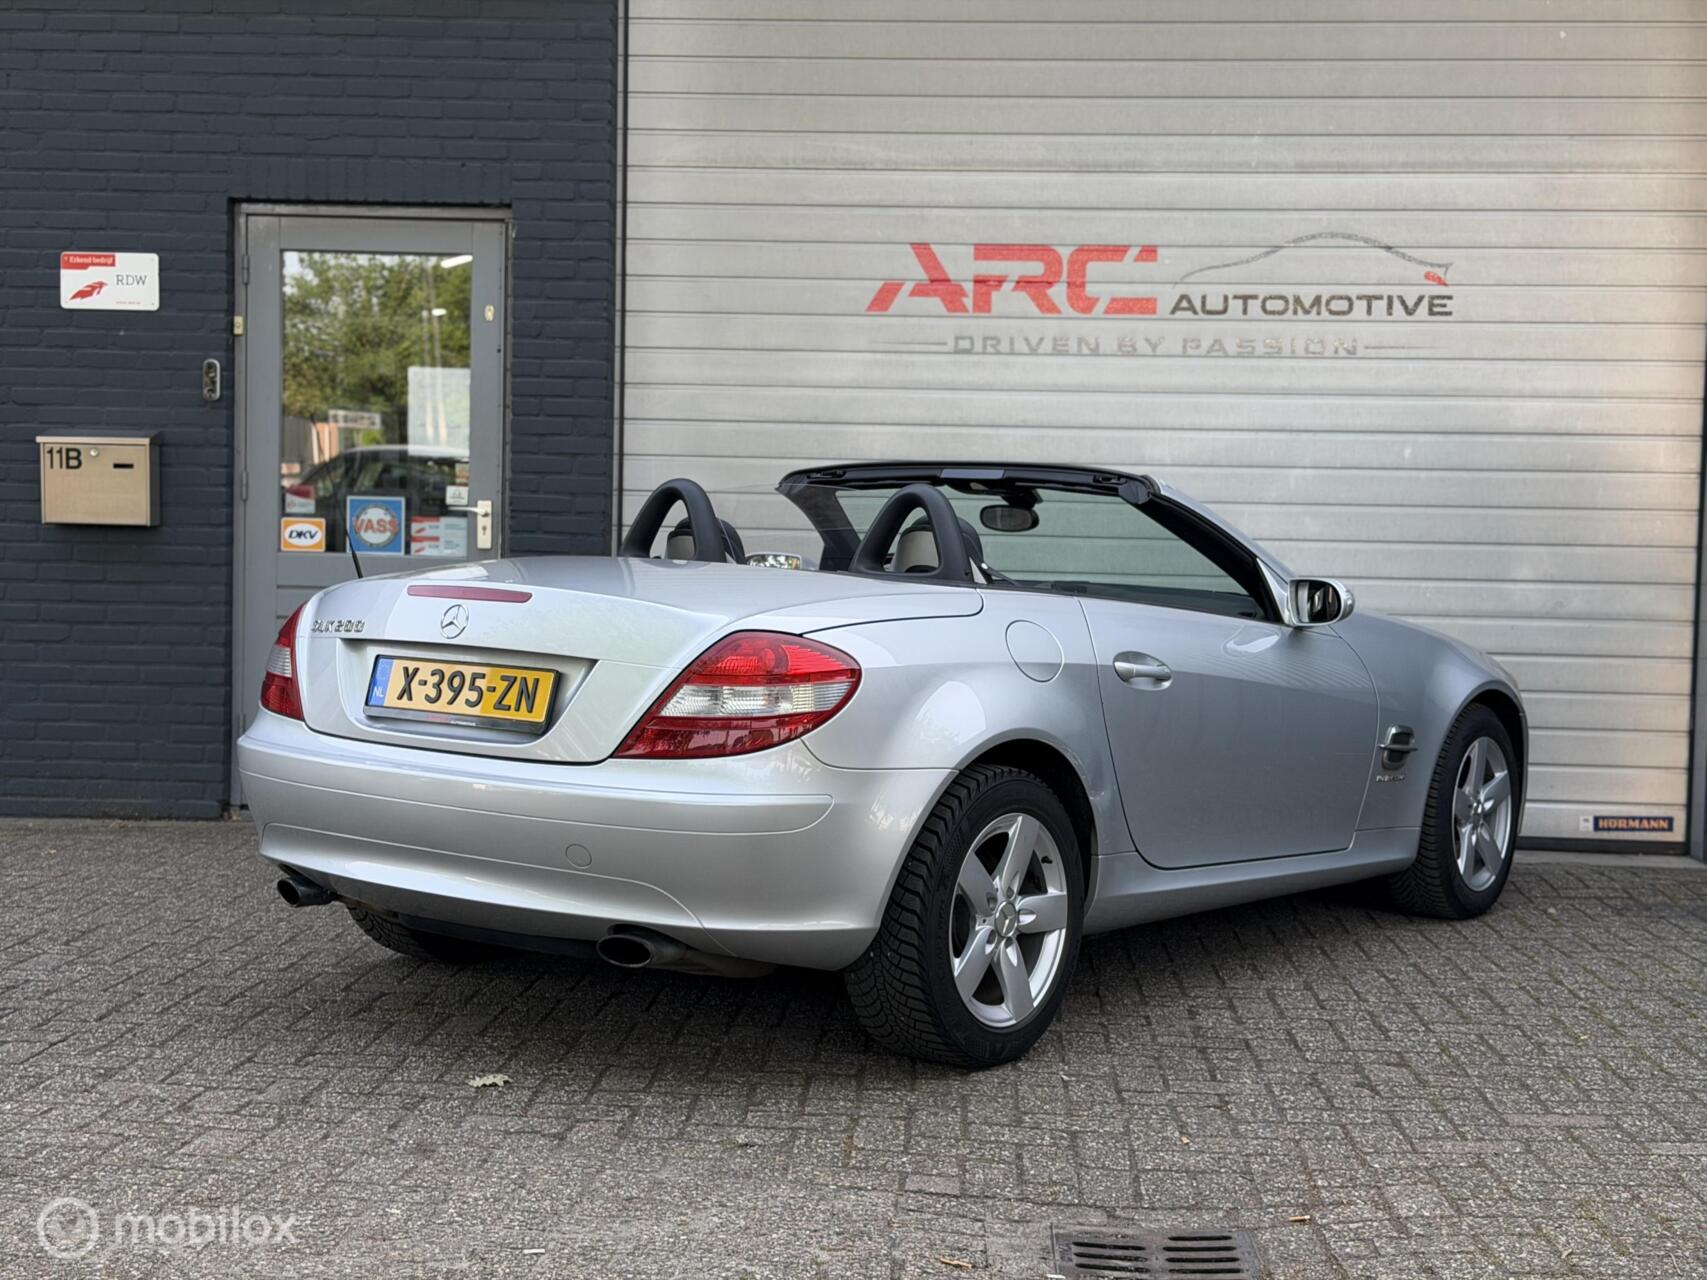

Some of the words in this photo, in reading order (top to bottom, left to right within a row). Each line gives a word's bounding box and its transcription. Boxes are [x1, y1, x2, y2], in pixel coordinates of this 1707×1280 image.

[115, 274, 148, 287] RDW
[865, 243, 1158, 316] ARC
[1170, 294, 1454, 317] AUTOMOTIVE
[954, 335, 1100, 354] DRIVEN
[1118, 336, 1166, 355] BY
[1182, 336, 1358, 357] PASSION
[47, 446, 83, 470] 11B
[287, 528, 319, 541] DKV
[352, 517, 399, 535] VASS
[372, 685, 385, 698] NL
[396, 665, 540, 714] X-395-ZN
